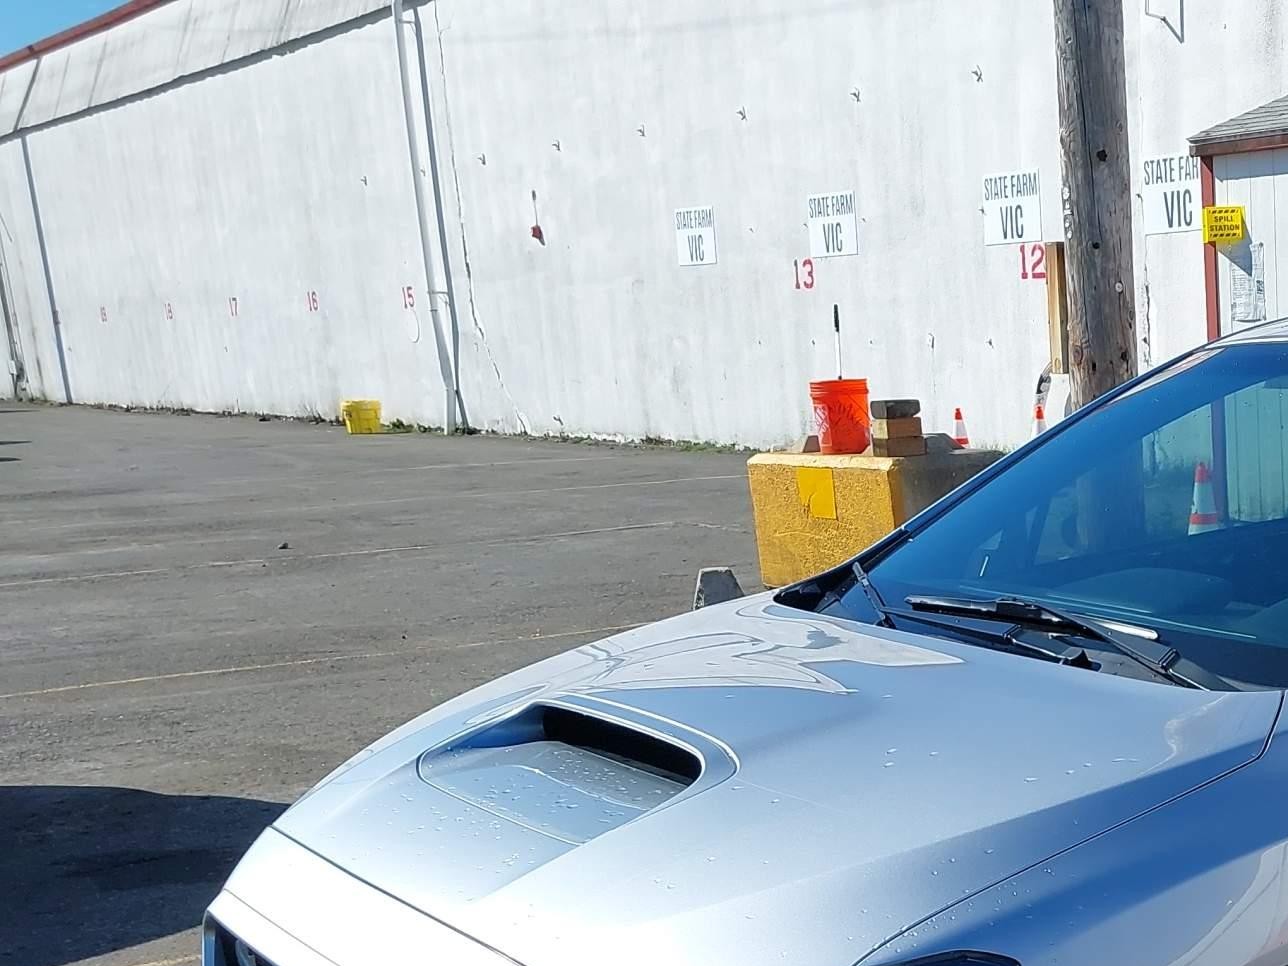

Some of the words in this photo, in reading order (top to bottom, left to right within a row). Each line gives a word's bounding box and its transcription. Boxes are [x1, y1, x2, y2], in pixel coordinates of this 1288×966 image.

[1144, 157, 1175, 186] STATE
[1179, 156, 1200, 181] FAR
[984, 175, 1008, 201] STATE
[1011, 172, 1038, 198] FARM
[676, 210, 694, 230] STATE
[694, 208, 713, 229] FARM
[808, 196, 830, 219] STATE
[832, 193, 854, 216] FARM
[1164, 189, 1193, 228] VIC
[1000, 204, 1024, 240] VIC
[1209, 224, 1240, 232] STATION
[687, 234, 705, 262] VIC
[822, 222, 843, 254] VIC
[793, 258, 814, 290] 13
[1019, 243, 1046, 280] 12
[229, 297, 238, 317] 17
[307, 291, 319, 312] 16
[401, 286, 415, 309] 15
